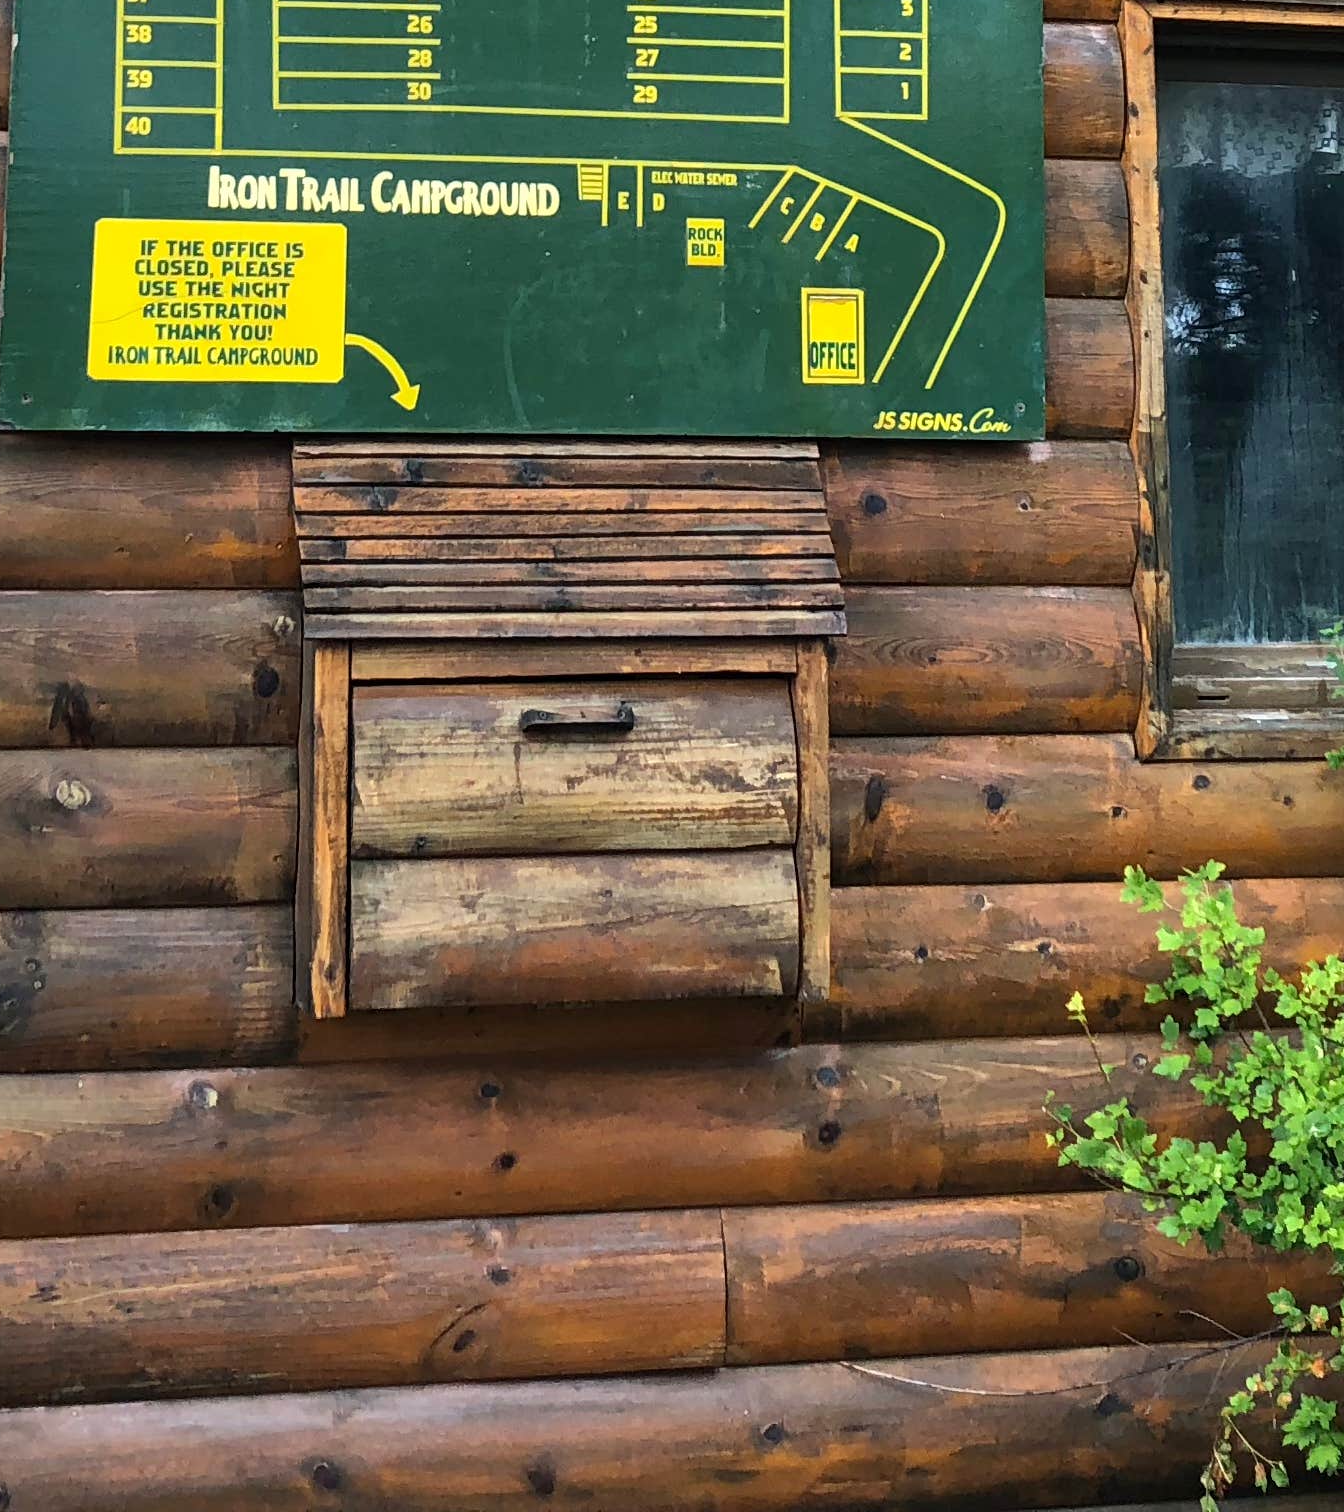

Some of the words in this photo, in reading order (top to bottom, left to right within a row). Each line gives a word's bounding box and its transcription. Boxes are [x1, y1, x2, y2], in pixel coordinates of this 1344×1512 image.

[902, 0, 913, 16] 3
[407, 15, 432, 33] 26
[634, 16, 657, 33] 25
[126, 24, 151, 43] 38
[409, 49, 432, 67] 28
[636, 49, 659, 66] 27
[900, 43, 911, 60] 2
[128, 70, 152, 88] 39
[408, 82, 431, 100] 30
[634, 85, 657, 103] 29
[902, 83, 908, 98] 1
[125, 117, 151, 135] 40
[652, 171, 673, 183] ELEC
[675, 172, 704, 184] WATER
[707, 173, 737, 185] SEWER
[208, 166, 276, 209] IRON
[279, 168, 365, 213] TRAIL
[371, 171, 559, 216] CAMPGROUND
[618, 192, 628, 209] E
[653, 194, 664, 211] D
[781, 198, 794, 215] C
[810, 214, 825, 231] B
[688, 227, 722, 240] ROCK
[141, 240, 157, 255] IF
[167, 241, 203, 256] THE
[213, 242, 277, 257] OFFICE
[286, 243, 303, 258] IS
[691, 244, 721, 257] BLD.
[845, 235, 858, 252] A
[135, 261, 214, 278] CLOSED,
[222, 261, 294, 277] PLEASE
[139, 281, 176, 296] USE
[186, 282, 223, 297] THE
[232, 283, 289, 297] NIGHT
[143, 303, 286, 319] REGISTRATION
[155, 324, 220, 340] THANK
[230, 325, 272, 340] YOU!
[109, 347, 148, 363] IRON
[155, 347, 201, 364] TRAIL
[208, 348, 318, 365] CAMPGROUND
[810, 342, 856, 369] OFFICE
